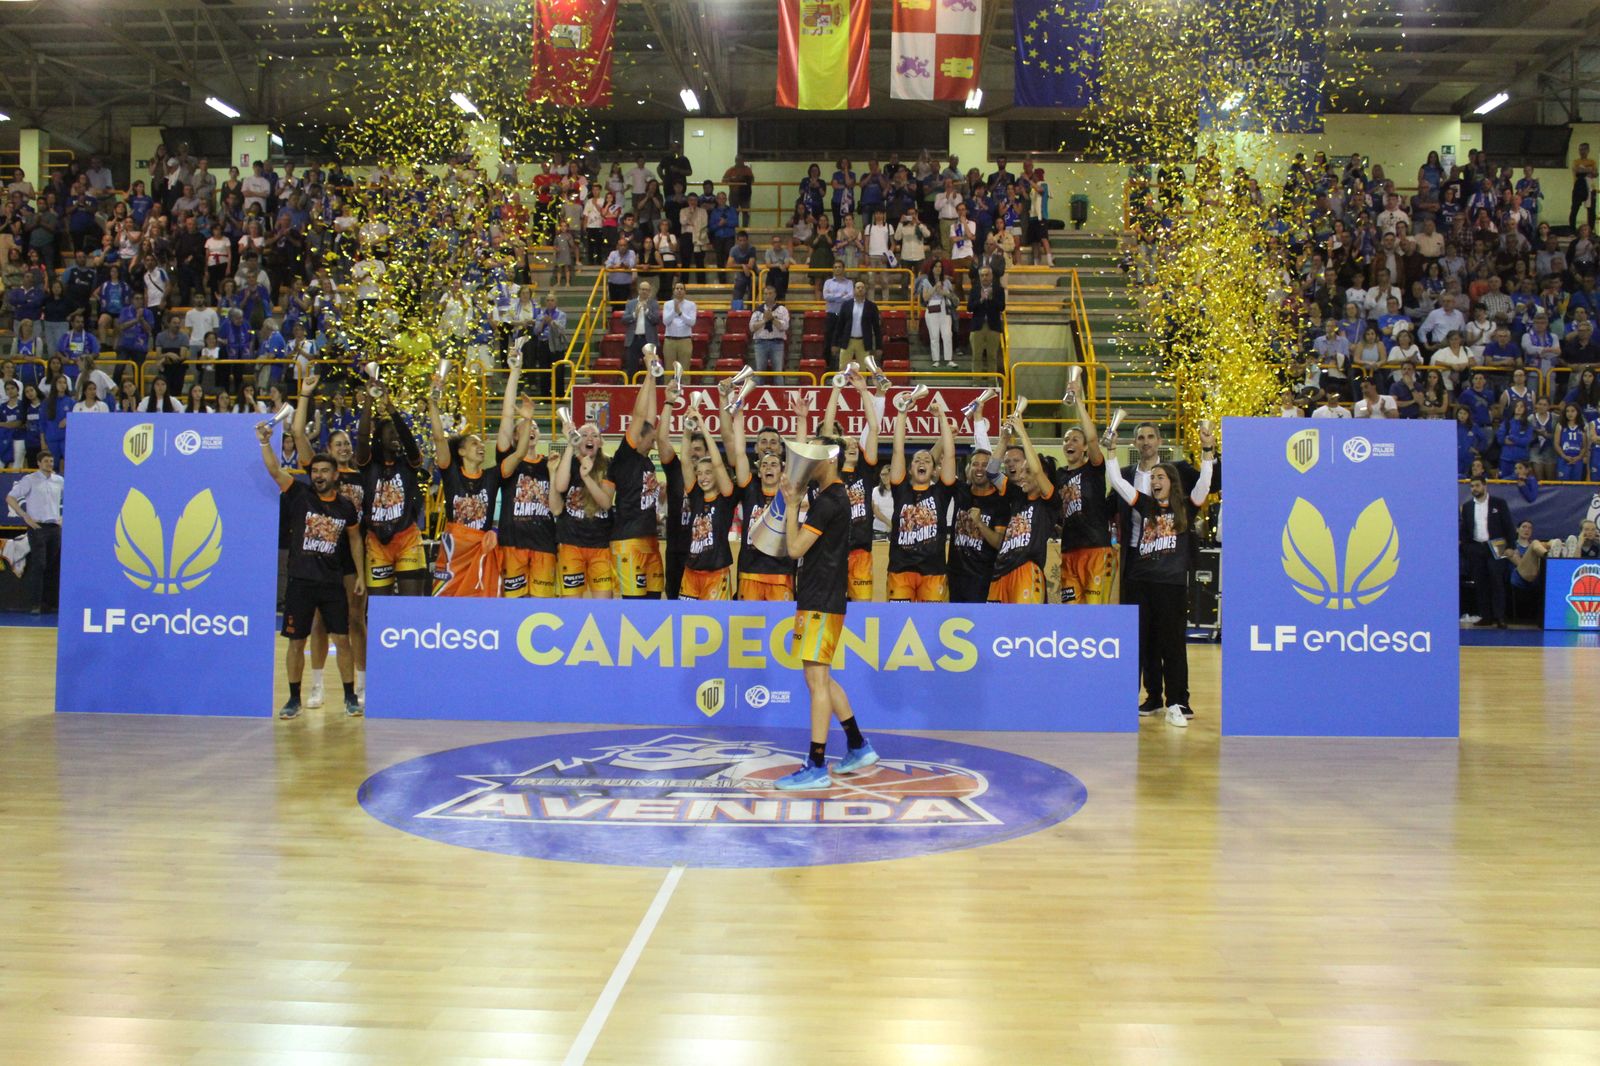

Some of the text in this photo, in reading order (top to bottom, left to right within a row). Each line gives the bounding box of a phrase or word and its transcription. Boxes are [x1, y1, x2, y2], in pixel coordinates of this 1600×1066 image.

[129, 432, 148, 458] 100
[1567, 432, 1577, 441] 11
[1292, 438, 1313, 465] 100
[83, 608, 248, 636] LF endesa
[380, 622, 499, 650] endesa
[992, 630, 1120, 659] endesa
[1250, 624, 1431, 653] LF endesa
[702, 686, 719, 709] 100
[452, 792, 970, 821] AVENIDA
